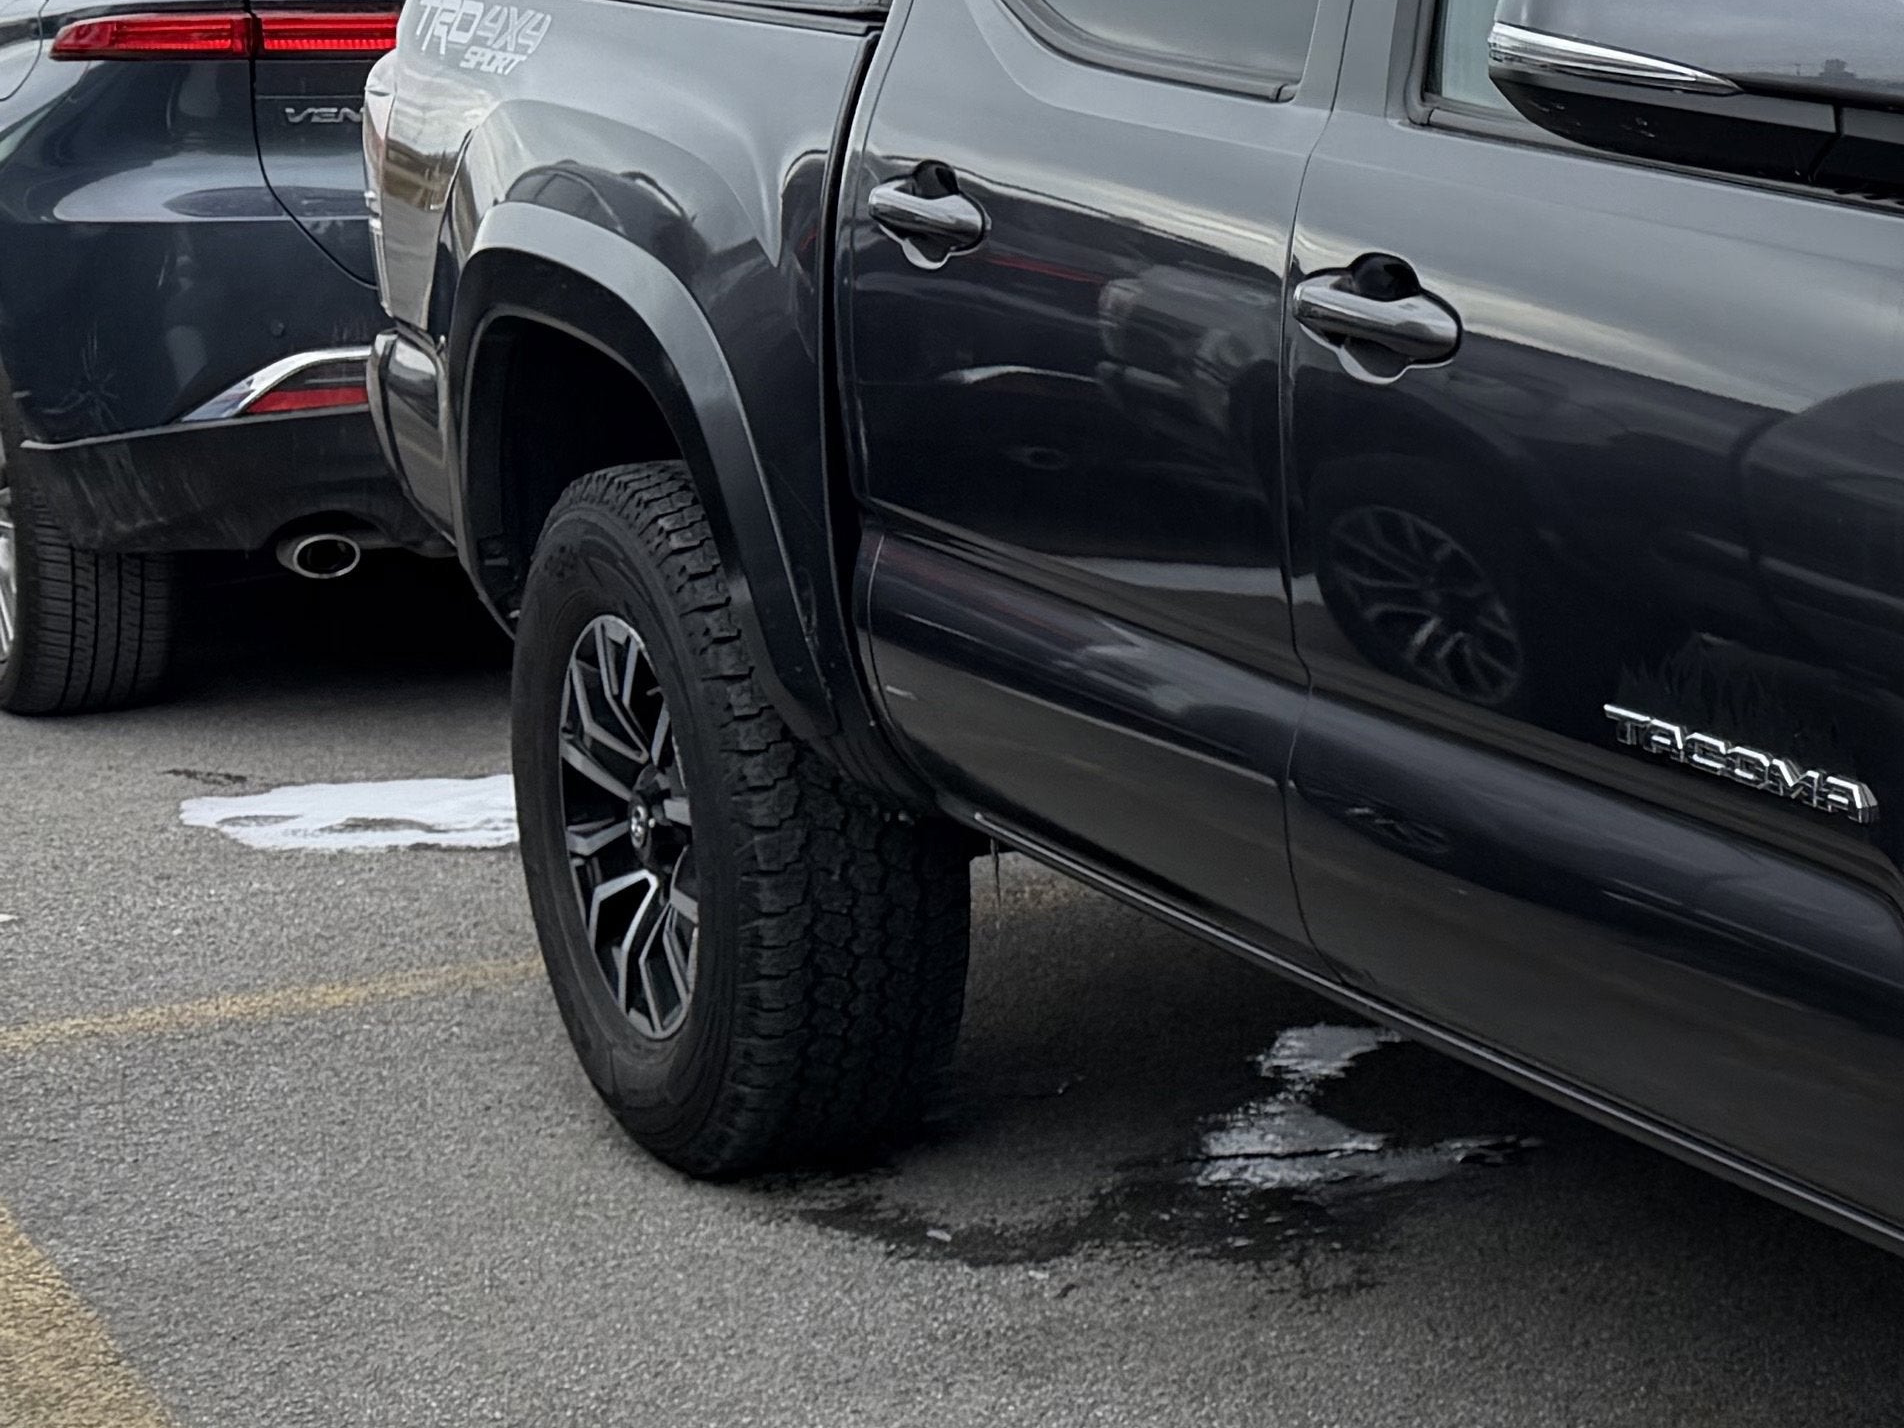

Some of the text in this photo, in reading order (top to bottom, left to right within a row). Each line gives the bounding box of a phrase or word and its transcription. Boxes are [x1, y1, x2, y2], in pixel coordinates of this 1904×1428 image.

[459, 46, 528, 76] SPORT
[285, 107, 364, 124] VEN
[1602, 703, 1880, 824] TACOMA
